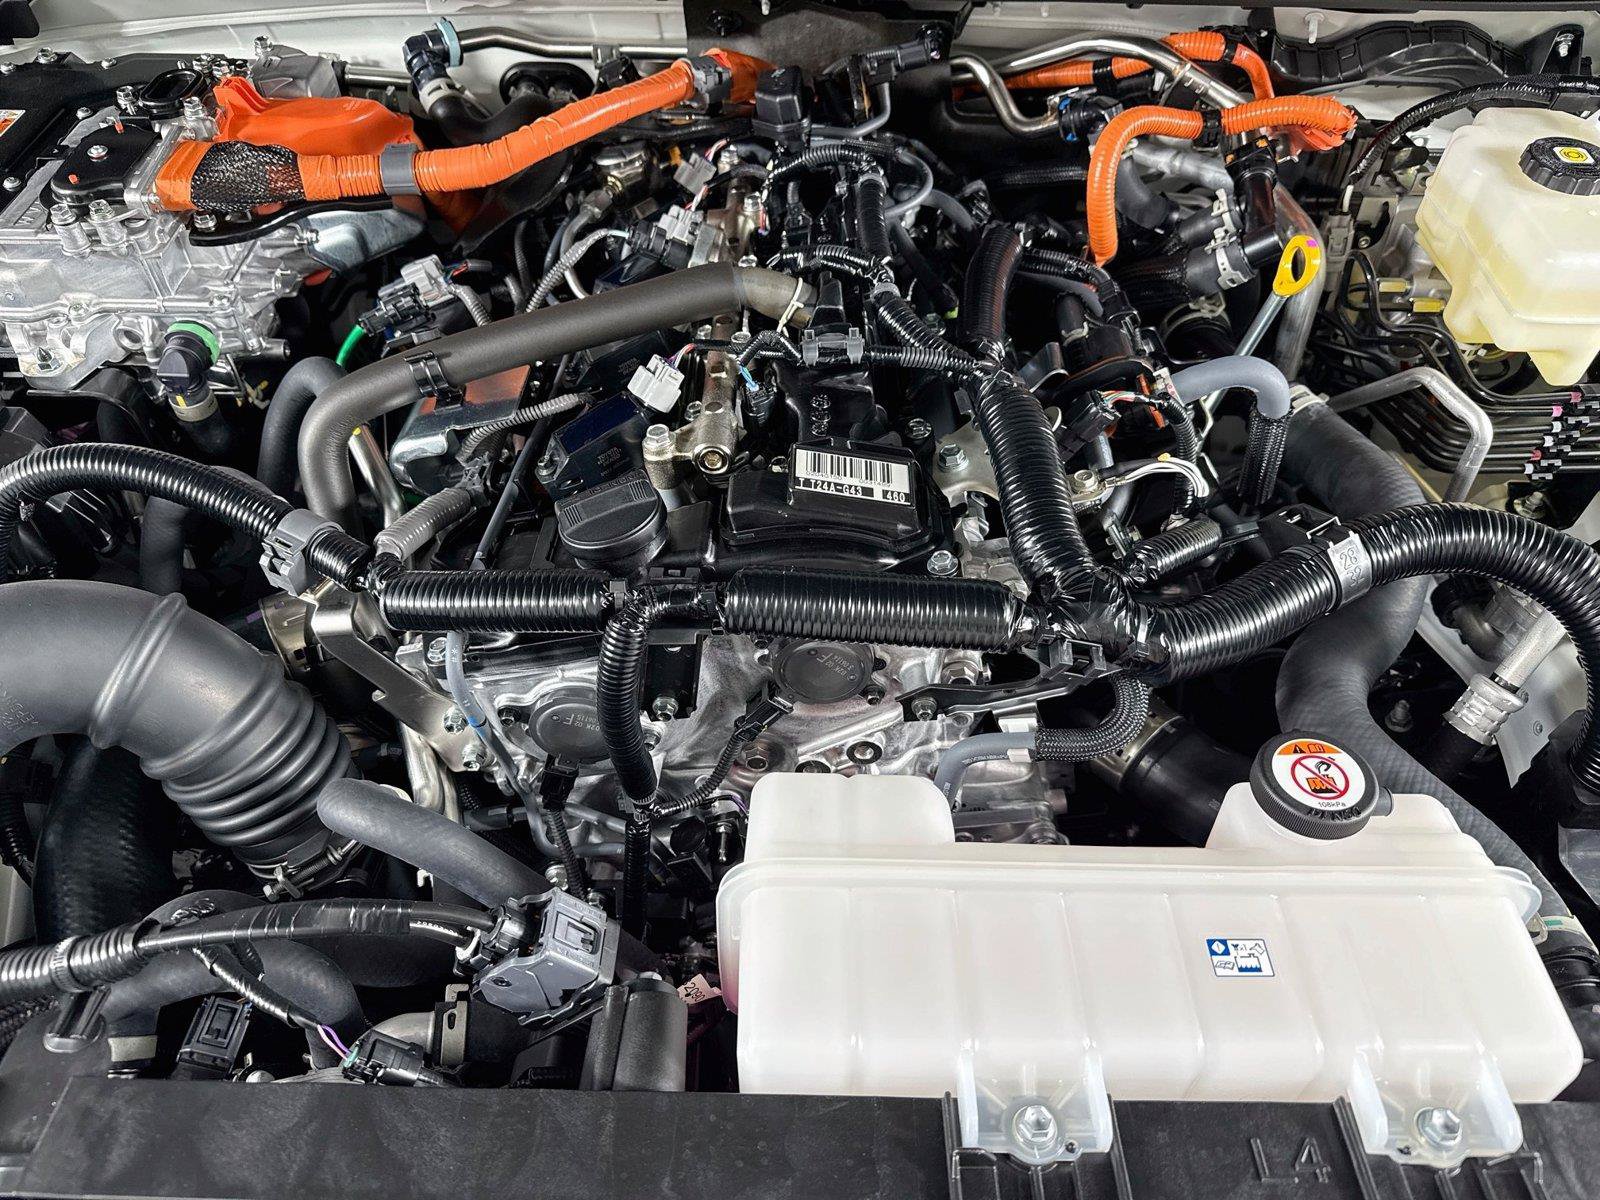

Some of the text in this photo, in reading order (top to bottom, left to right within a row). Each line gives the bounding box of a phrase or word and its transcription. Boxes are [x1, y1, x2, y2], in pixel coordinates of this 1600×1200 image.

[809, 479, 863, 496] T24A-G43
[886, 491, 906, 503] 460
[1339, 546, 1359, 571] 28
[1346, 565, 1365, 588] 32
[816, 652, 834, 664] F
[562, 713, 575, 726] F
[1317, 800, 1347, 808] 108kPa
